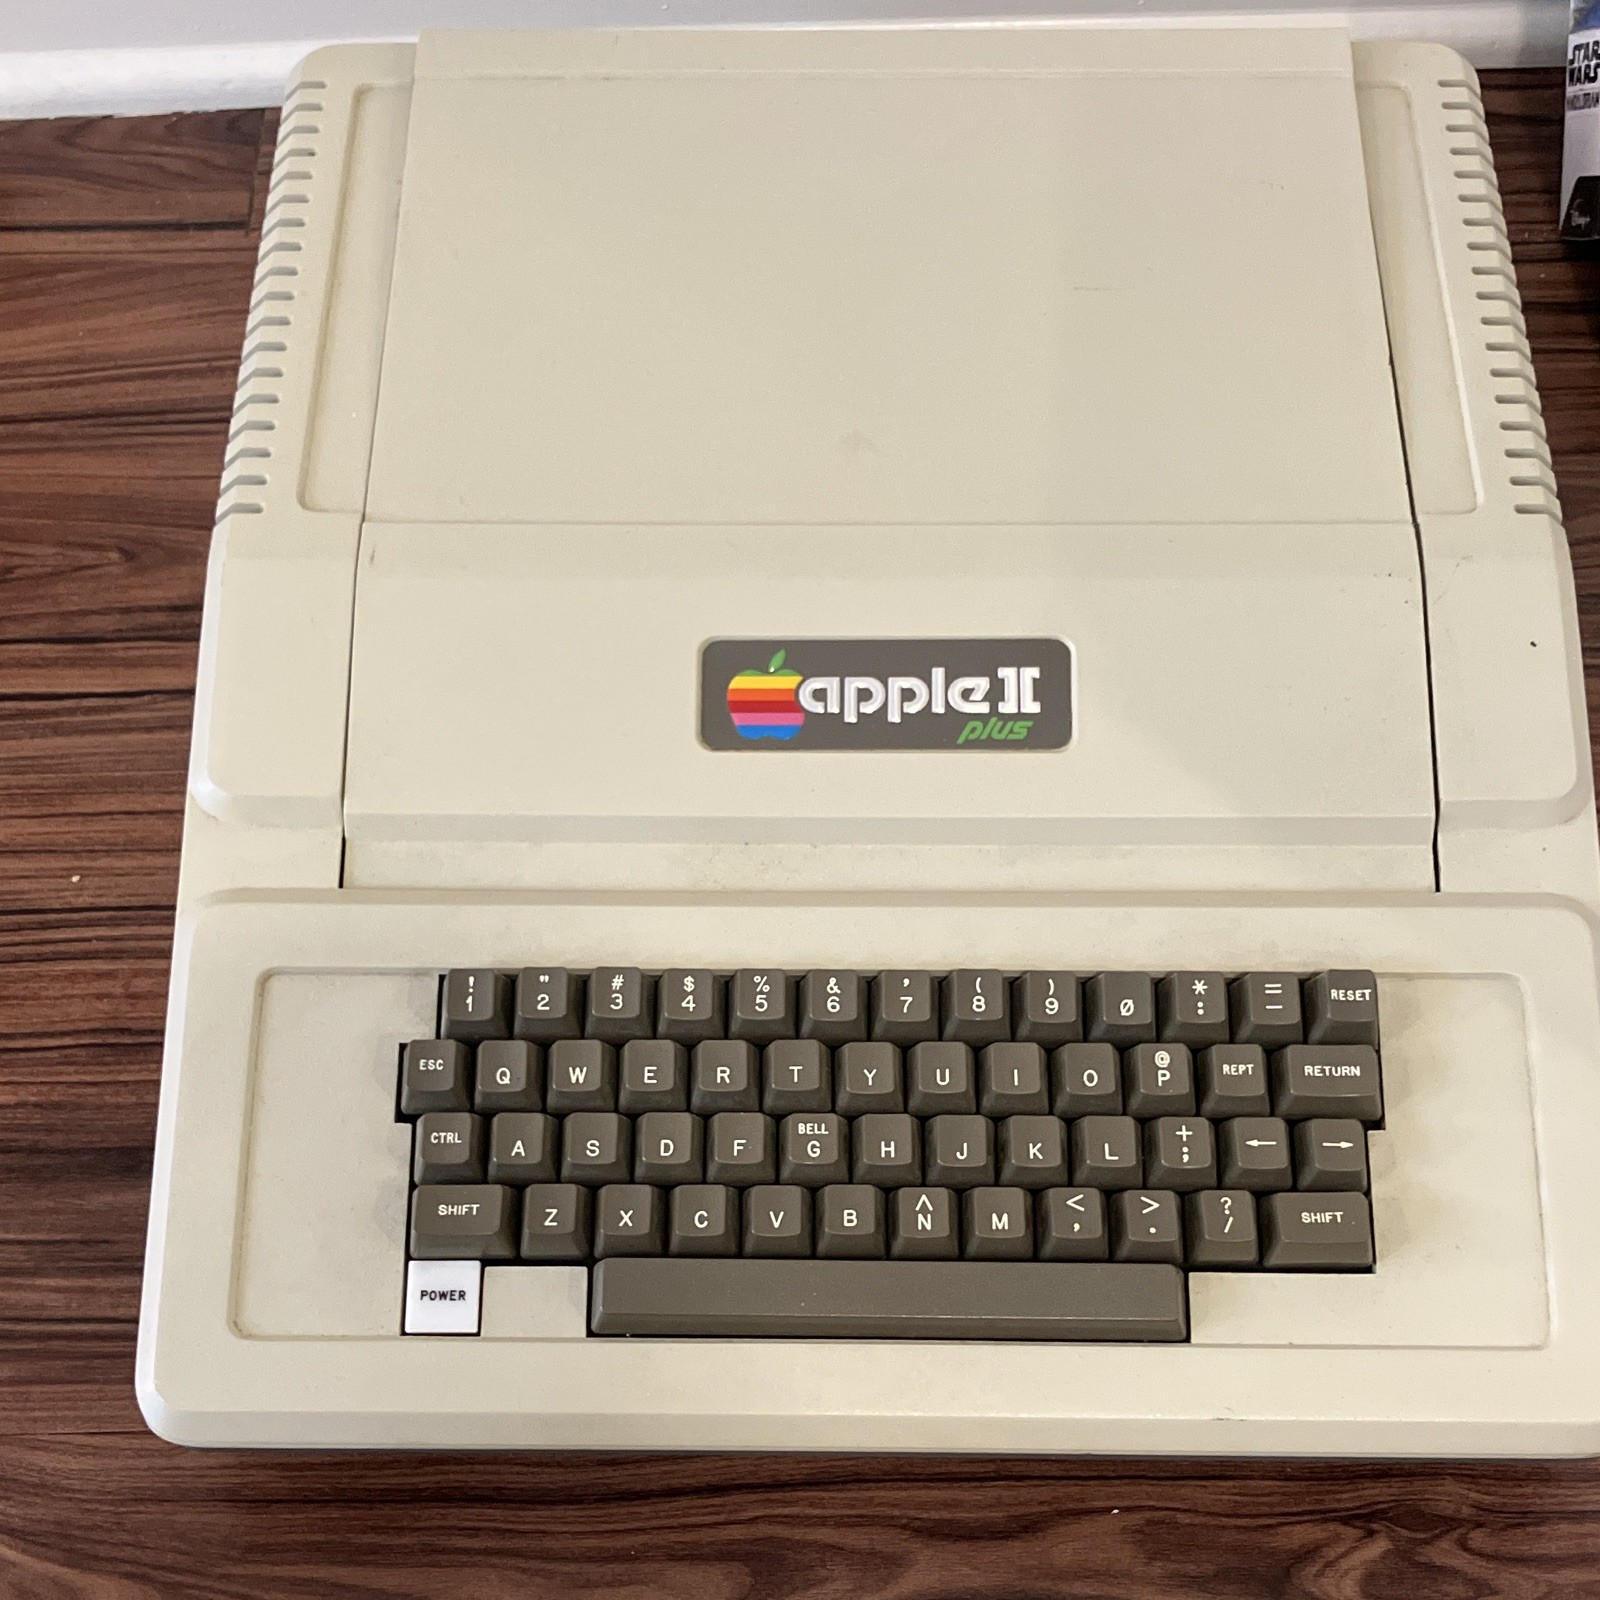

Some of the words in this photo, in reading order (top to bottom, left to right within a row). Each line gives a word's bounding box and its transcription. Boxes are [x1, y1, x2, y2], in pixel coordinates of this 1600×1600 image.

[1568, 40, 1600, 66] STAR
[1567, 62, 1600, 86] WARS
[798, 667, 990, 724] apple
[956, 716, 1034, 744] plus
[537, 994, 551, 1011] 2
[610, 993, 624, 1010] 3
[681, 995, 697, 1012] 4
[755, 995, 768, 1013] 5
[1331, 989, 1372, 1002] RESET
[465, 996, 473, 1013] 1
[827, 996, 841, 1013] 6
[900, 997, 914, 1014] 7
[972, 996, 986, 1013] 8
[1045, 998, 1059, 1015] 9
[419, 1059, 444, 1071] ESC
[1223, 1064, 1255, 1076] REPT
[1304, 1065, 1361, 1077] RETURN
[496, 1067, 511, 1085] Q
[569, 1067, 588, 1084] W
[644, 1067, 658, 1084] E
[717, 1067, 731, 1084] R
[789, 1066, 804, 1083] T
[864, 1069, 877, 1086] Y
[936, 1068, 950, 1086] U
[1013, 1069, 1019, 1087] I
[1083, 1070, 1099, 1088] O
[1156, 1069, 1171, 1087] P
[798, 1123, 830, 1135] BELL
[431, 1132, 462, 1144] CTRL
[511, 1140, 526, 1157] A
[586, 1140, 600, 1158] S
[660, 1140, 675, 1157] D
[734, 1140, 747, 1157] F
[807, 1141, 821, 1158] G
[881, 1141, 896, 1159] H
[956, 1143, 968, 1160] J
[1029, 1143, 1044, 1160] K
[1105, 1143, 1120, 1161] L
[438, 1204, 481, 1216] SHIFT
[544, 1209, 559, 1227] Z
[619, 1210, 634, 1227] X
[844, 1210, 858, 1227] B
[1301, 1212, 1344, 1224] SHIFT
[694, 1211, 709, 1229] C
[770, 1211, 785, 1229] V
[916, 1212, 933, 1231] N
[992, 1213, 1009, 1231] M
[420, 1290, 467, 1302] POWER
